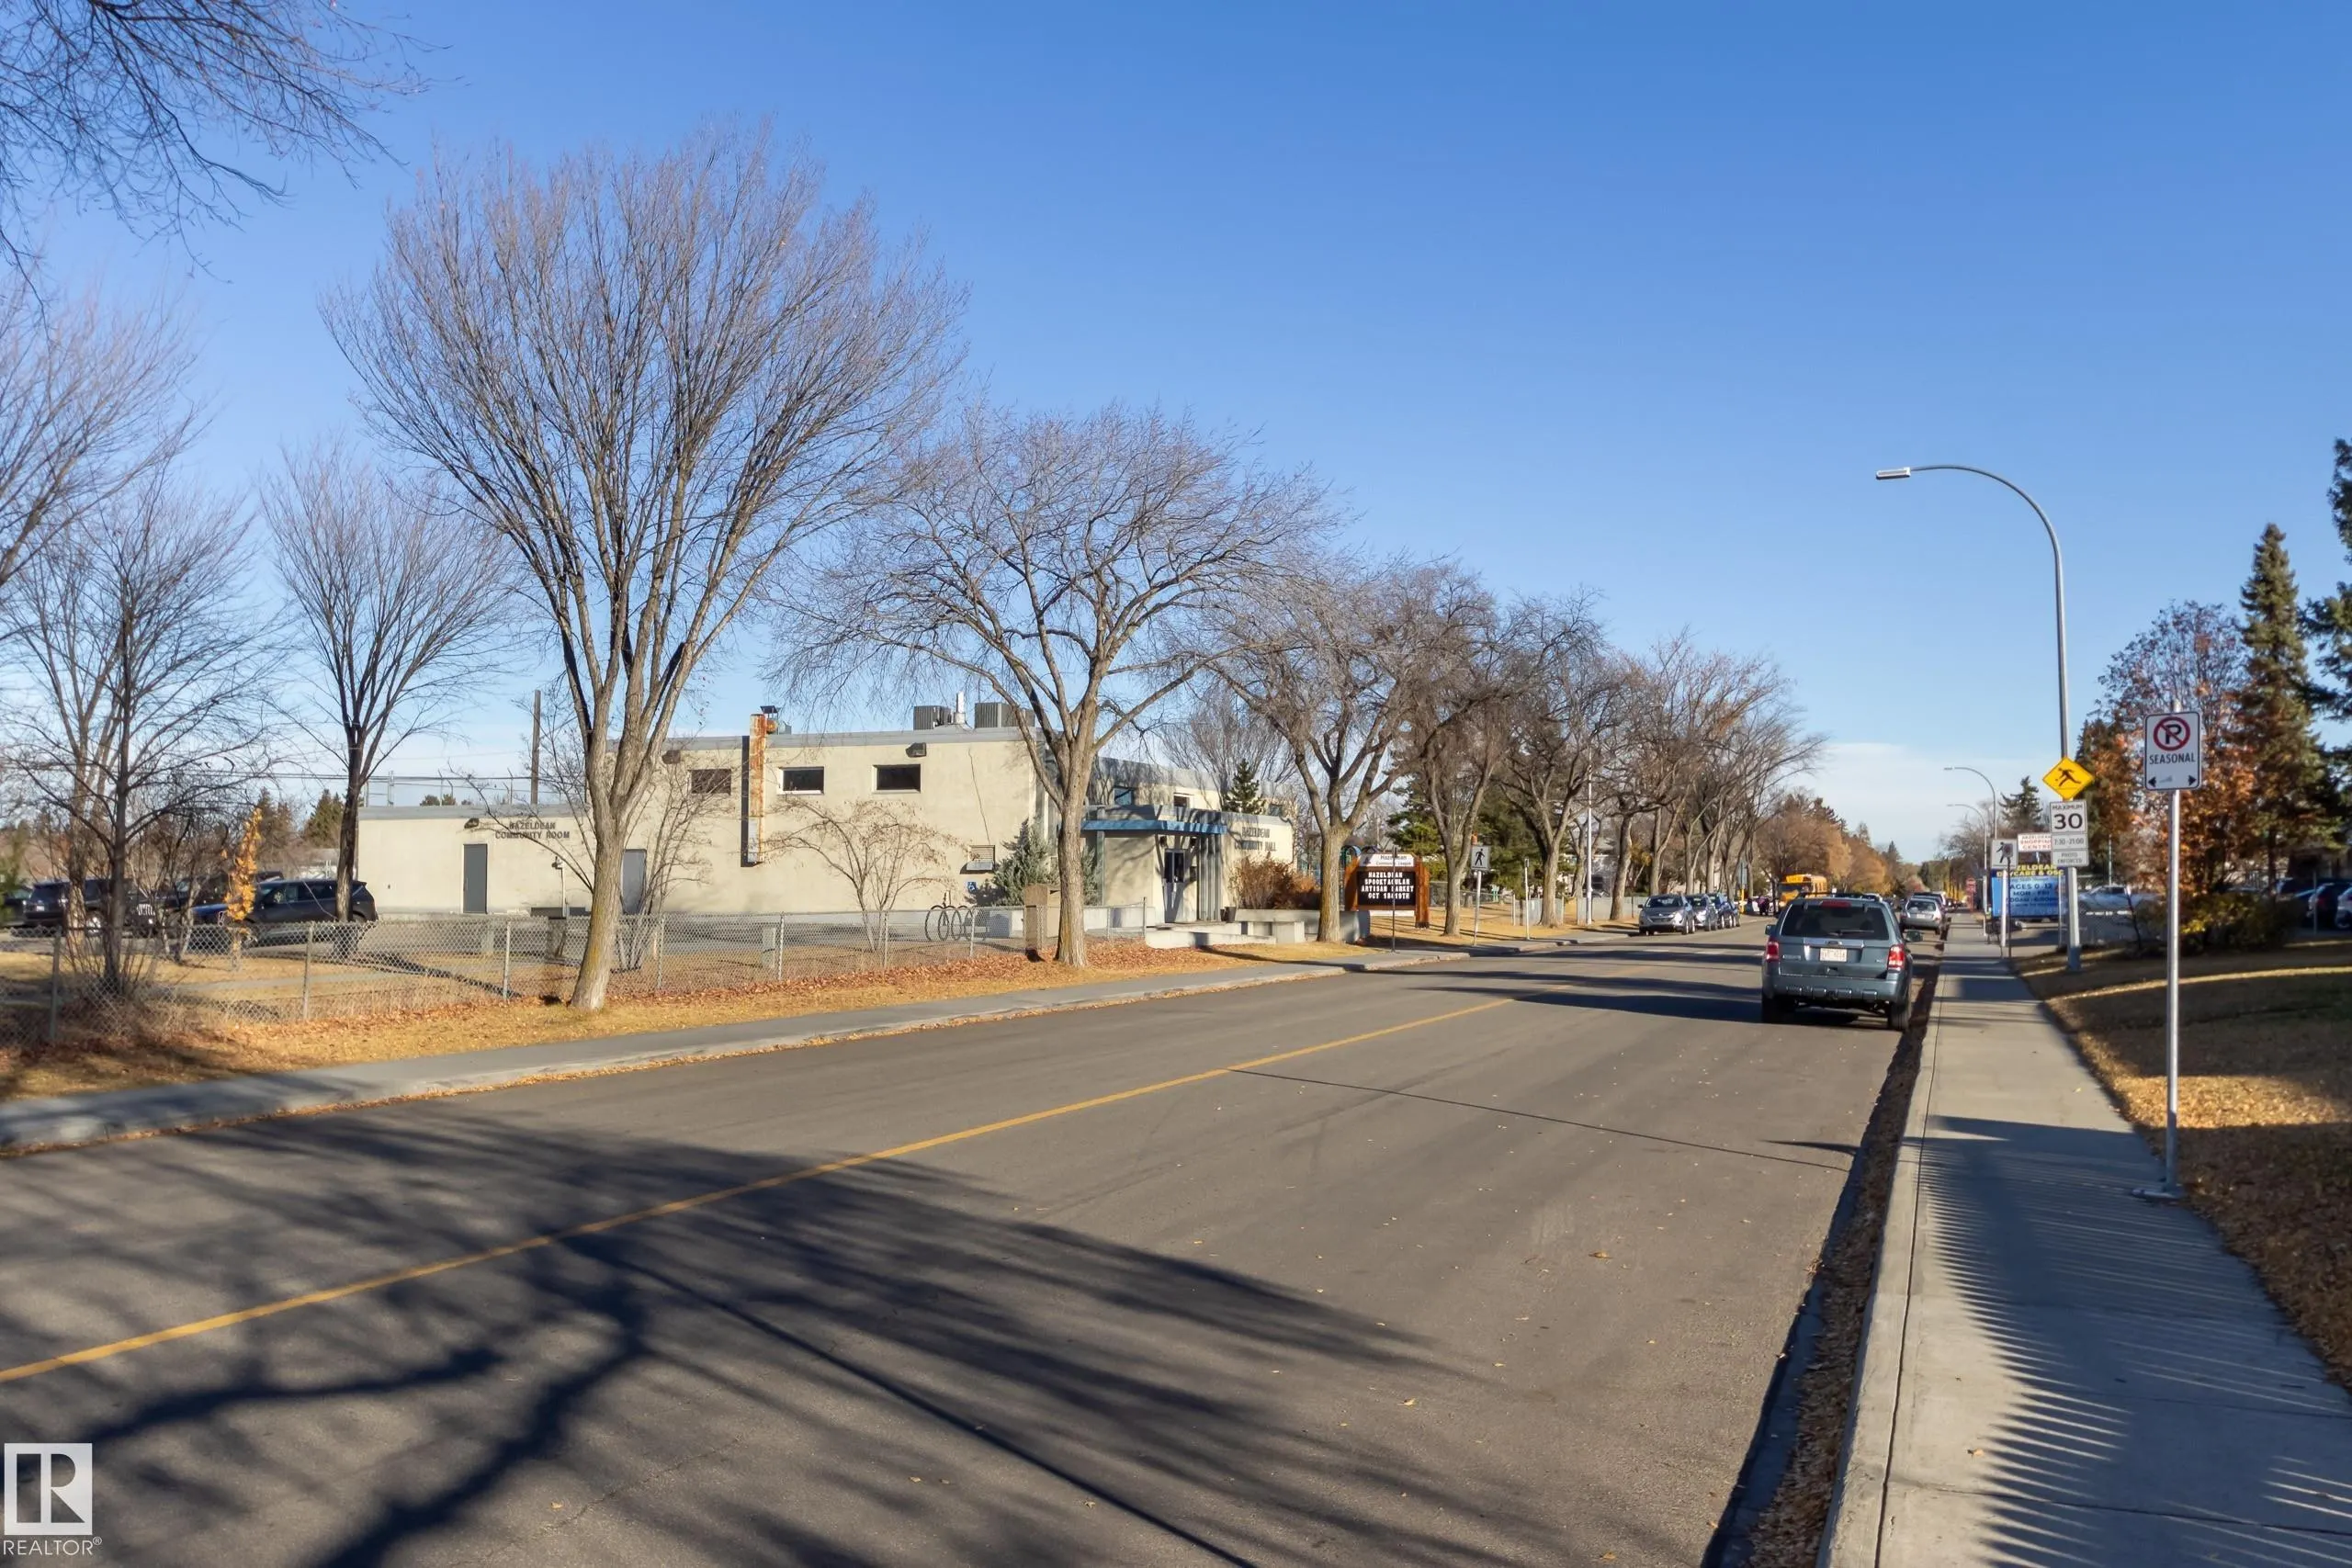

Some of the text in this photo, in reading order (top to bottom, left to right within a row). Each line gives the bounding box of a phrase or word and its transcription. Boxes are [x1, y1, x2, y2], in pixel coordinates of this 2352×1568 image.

[2149, 752, 2196, 764] SEASONAL
[510, 821, 556, 829] HAZELDEAN
[2054, 813, 2083, 829] 30
[495, 830, 570, 839] COMMUNITY ROOM
[1996, 869, 2037, 877] DYCARE
